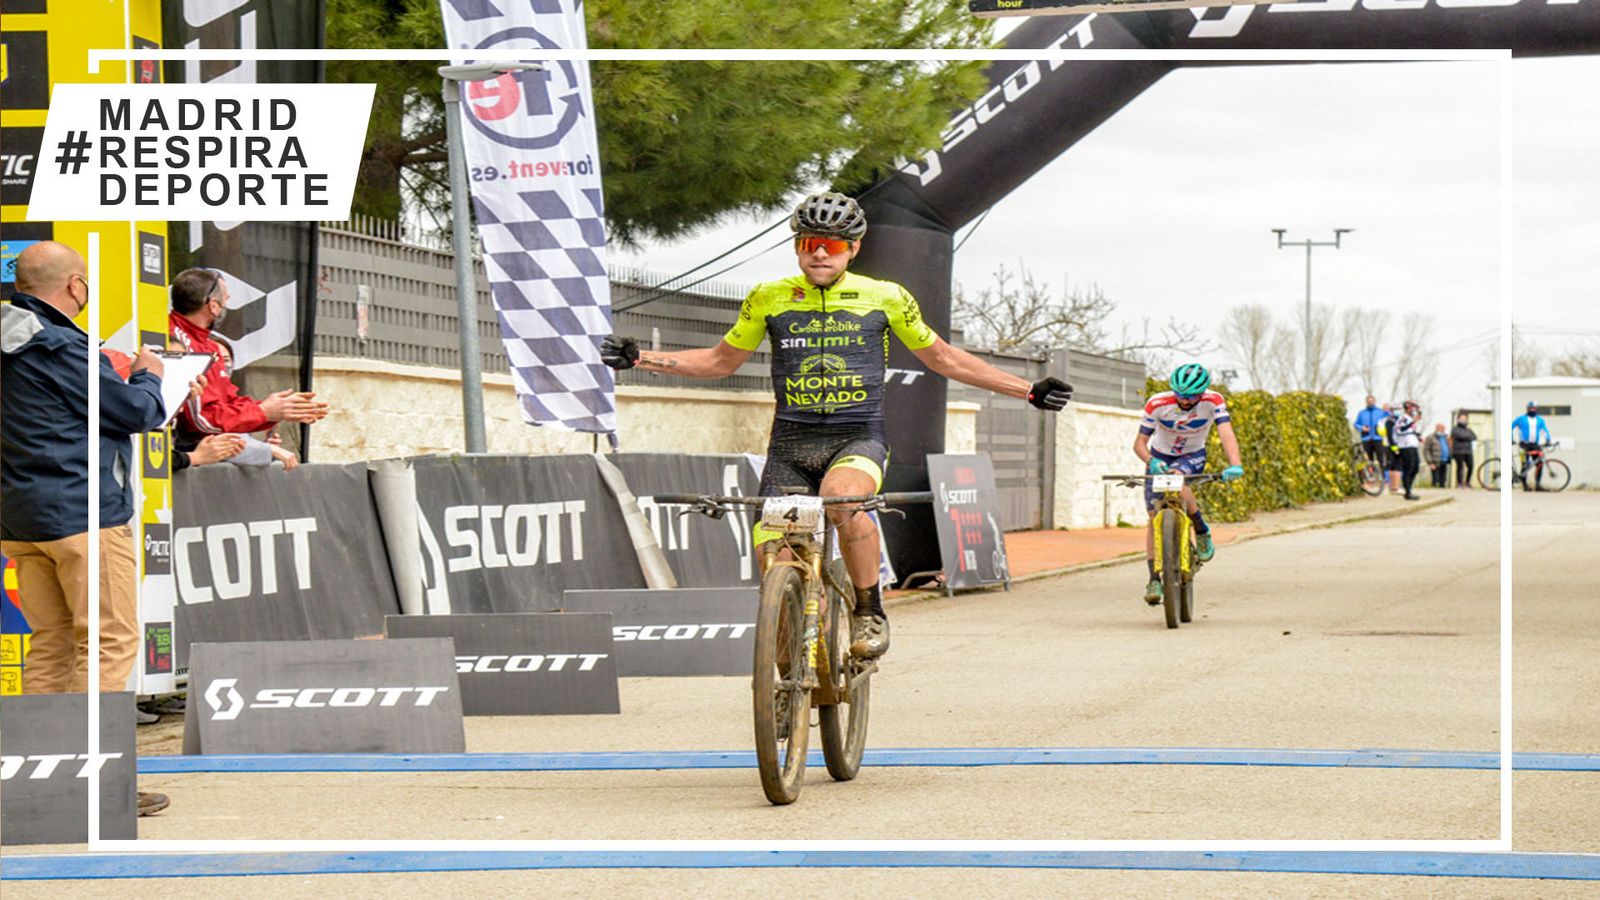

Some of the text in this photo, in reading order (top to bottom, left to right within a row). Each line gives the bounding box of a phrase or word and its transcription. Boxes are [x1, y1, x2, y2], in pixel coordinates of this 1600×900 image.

[785, 375, 864, 391] MONTE
[785, 390, 868, 406] NEVADO
[948, 489, 978, 504] SCOTT
[783, 506, 799, 523] 4
[444, 500, 586, 573] SCOTT
[612, 623, 756, 641] SCOTT
[454, 653, 609, 673] SCOTT
[249, 686, 449, 708] SCOTT
